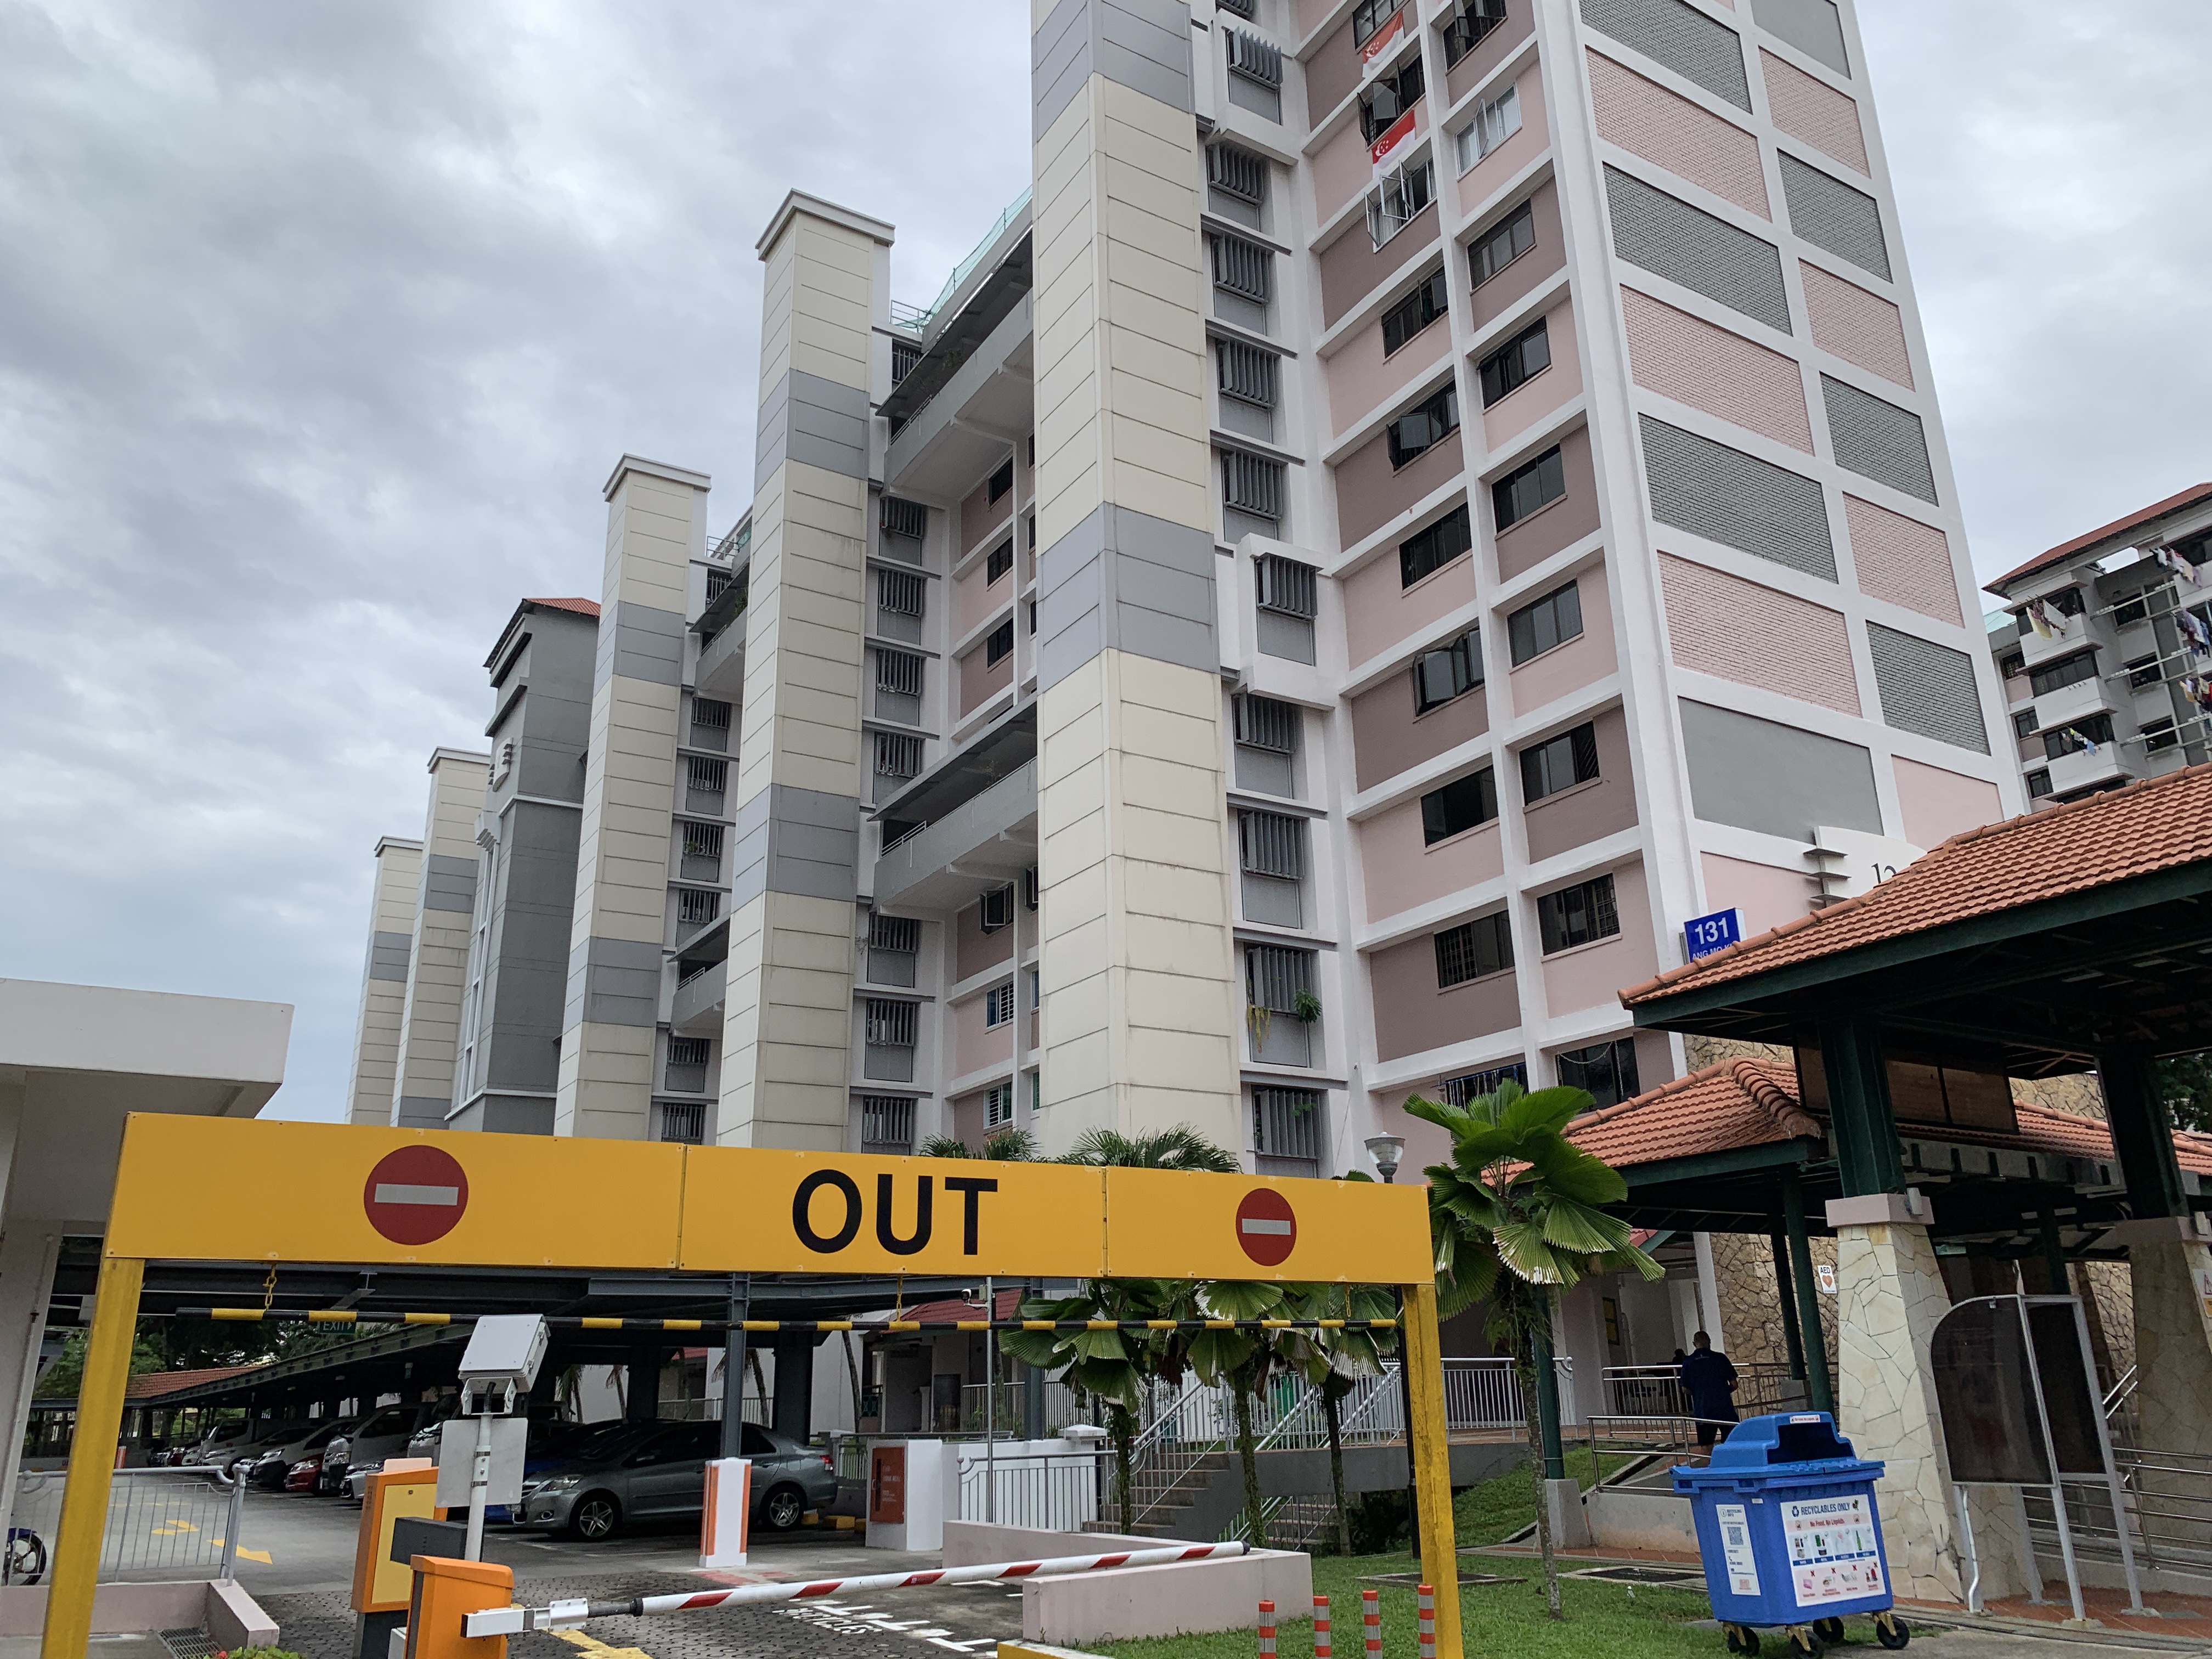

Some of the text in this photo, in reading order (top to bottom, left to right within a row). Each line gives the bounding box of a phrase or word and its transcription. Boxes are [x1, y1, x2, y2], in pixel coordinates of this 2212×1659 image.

[1695, 917, 1729, 945] 131
[1692, 950, 1708, 960] ANG
[792, 1169, 997, 1255] OUT
[1801, 1502, 1850, 1515] RECYCLABLES ONLY
